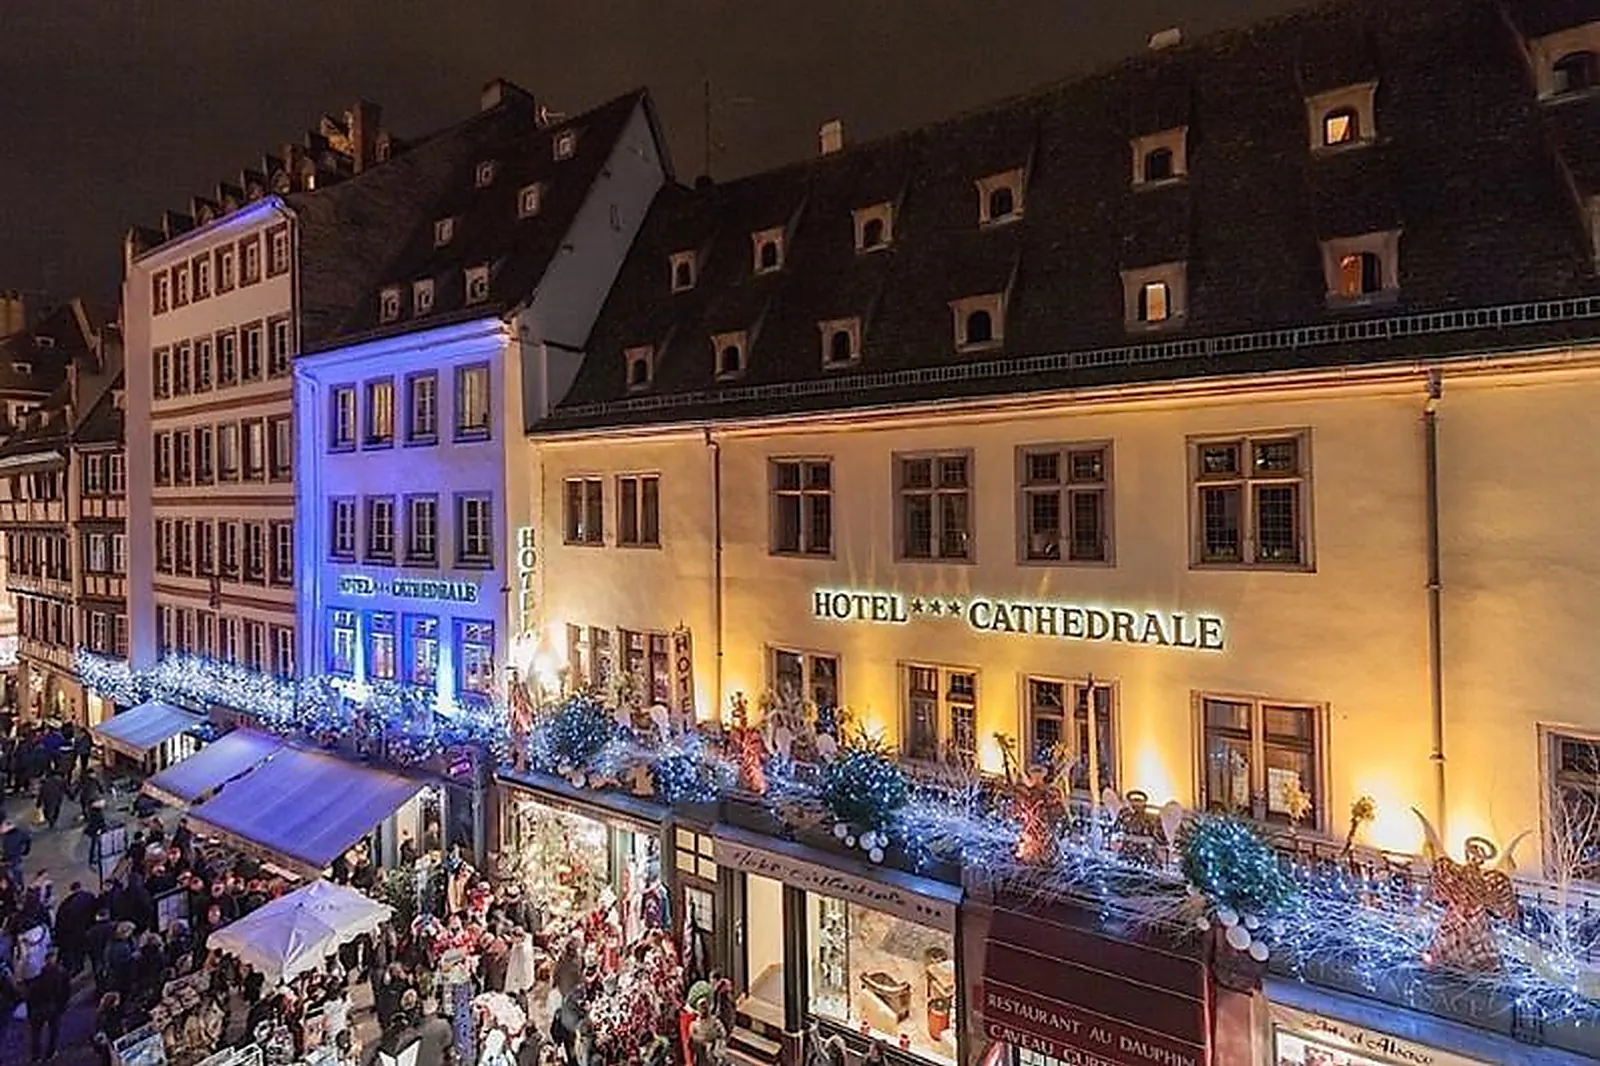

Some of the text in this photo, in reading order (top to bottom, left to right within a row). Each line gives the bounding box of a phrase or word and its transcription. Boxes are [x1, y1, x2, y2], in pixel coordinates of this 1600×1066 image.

[814, 590, 1225, 650] HOTEL CATHEDRALE
[987, 994, 1197, 1066] RESTAURANT AU DAUPHIN
[989, 1024, 1053, 1055] CAVEAU
